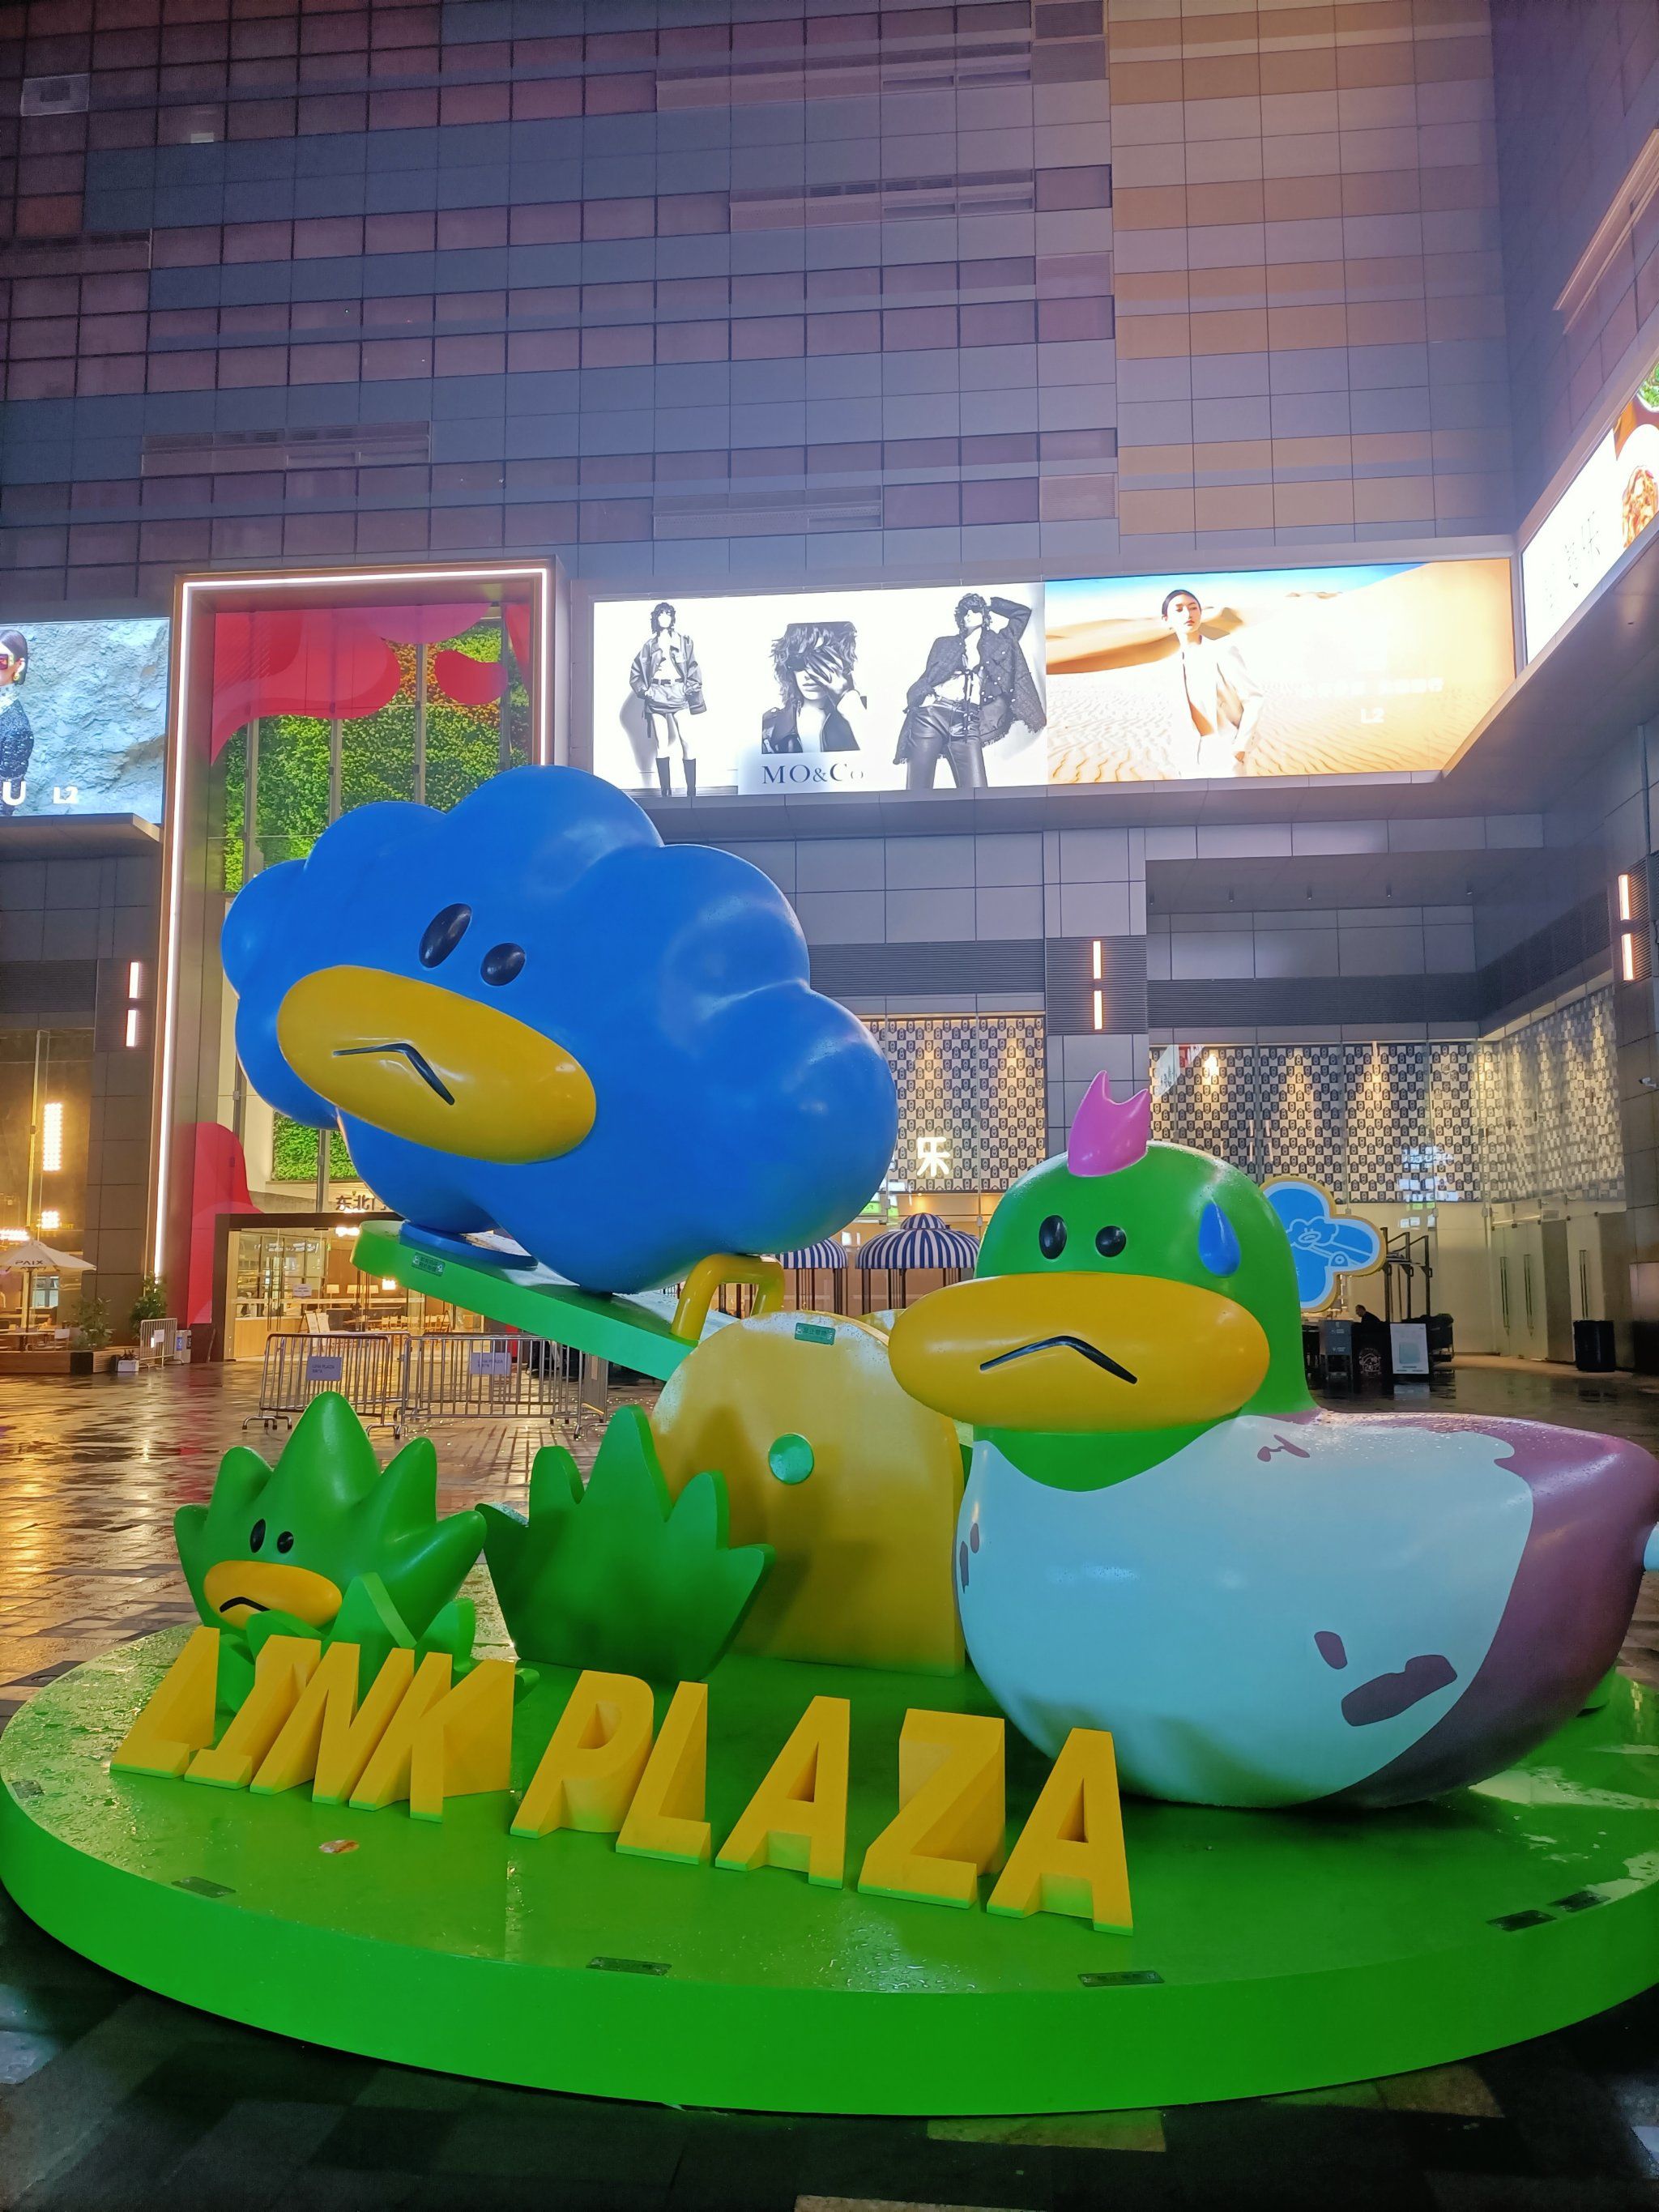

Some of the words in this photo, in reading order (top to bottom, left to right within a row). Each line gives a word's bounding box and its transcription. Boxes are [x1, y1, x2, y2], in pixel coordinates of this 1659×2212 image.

[1360, 707, 1385, 724] L2
[53, 786, 79, 804] L2
[916, 1136, 951, 1178] 乐
[109, 1626, 515, 1823] LINK
[510, 1669, 1134, 1937] PLAZA
